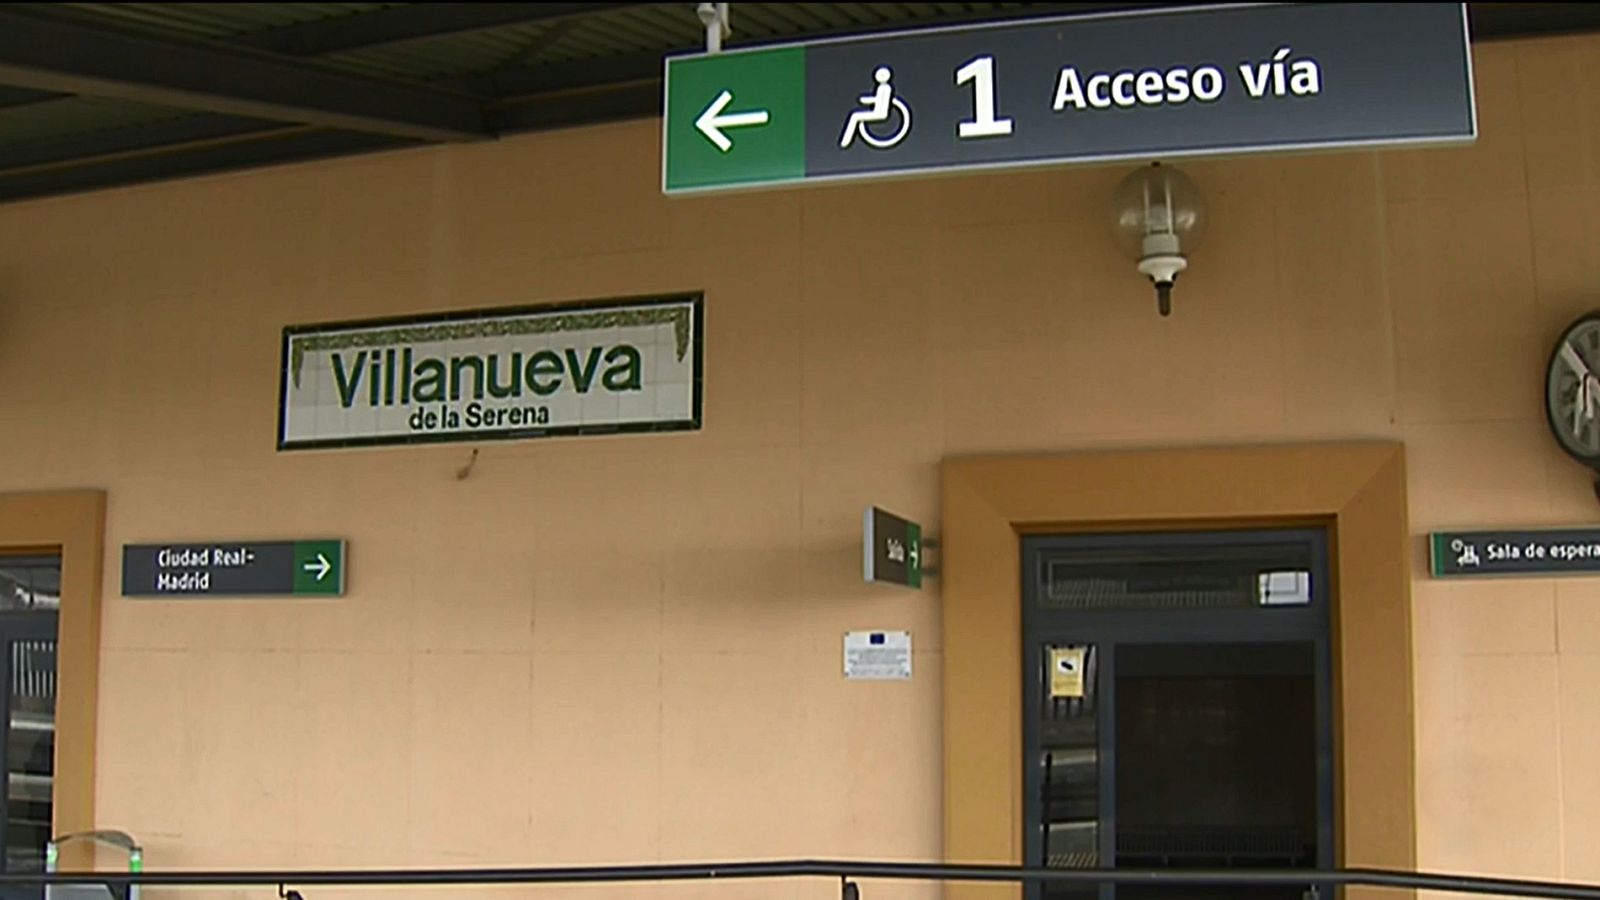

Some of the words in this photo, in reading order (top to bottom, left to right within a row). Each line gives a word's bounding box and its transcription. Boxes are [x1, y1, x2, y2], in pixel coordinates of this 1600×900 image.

[955, 57, 1013, 138] 1
[1053, 66, 1223, 111] Acceso
[1239, 48, 1321, 98] vía
[331, 344, 643, 408] Villanueva
[409, 408, 438, 430] de
[441, 405, 460, 428] la
[465, 403, 550, 428] Serena
[158, 549, 209, 567] Ciudad
[213, 548, 255, 566] Real-
[1487, 544, 1520, 560] Sala
[1525, 543, 1545, 559] de
[1550, 544, 1600, 560] espera
[157, 572, 210, 590] Madrid
